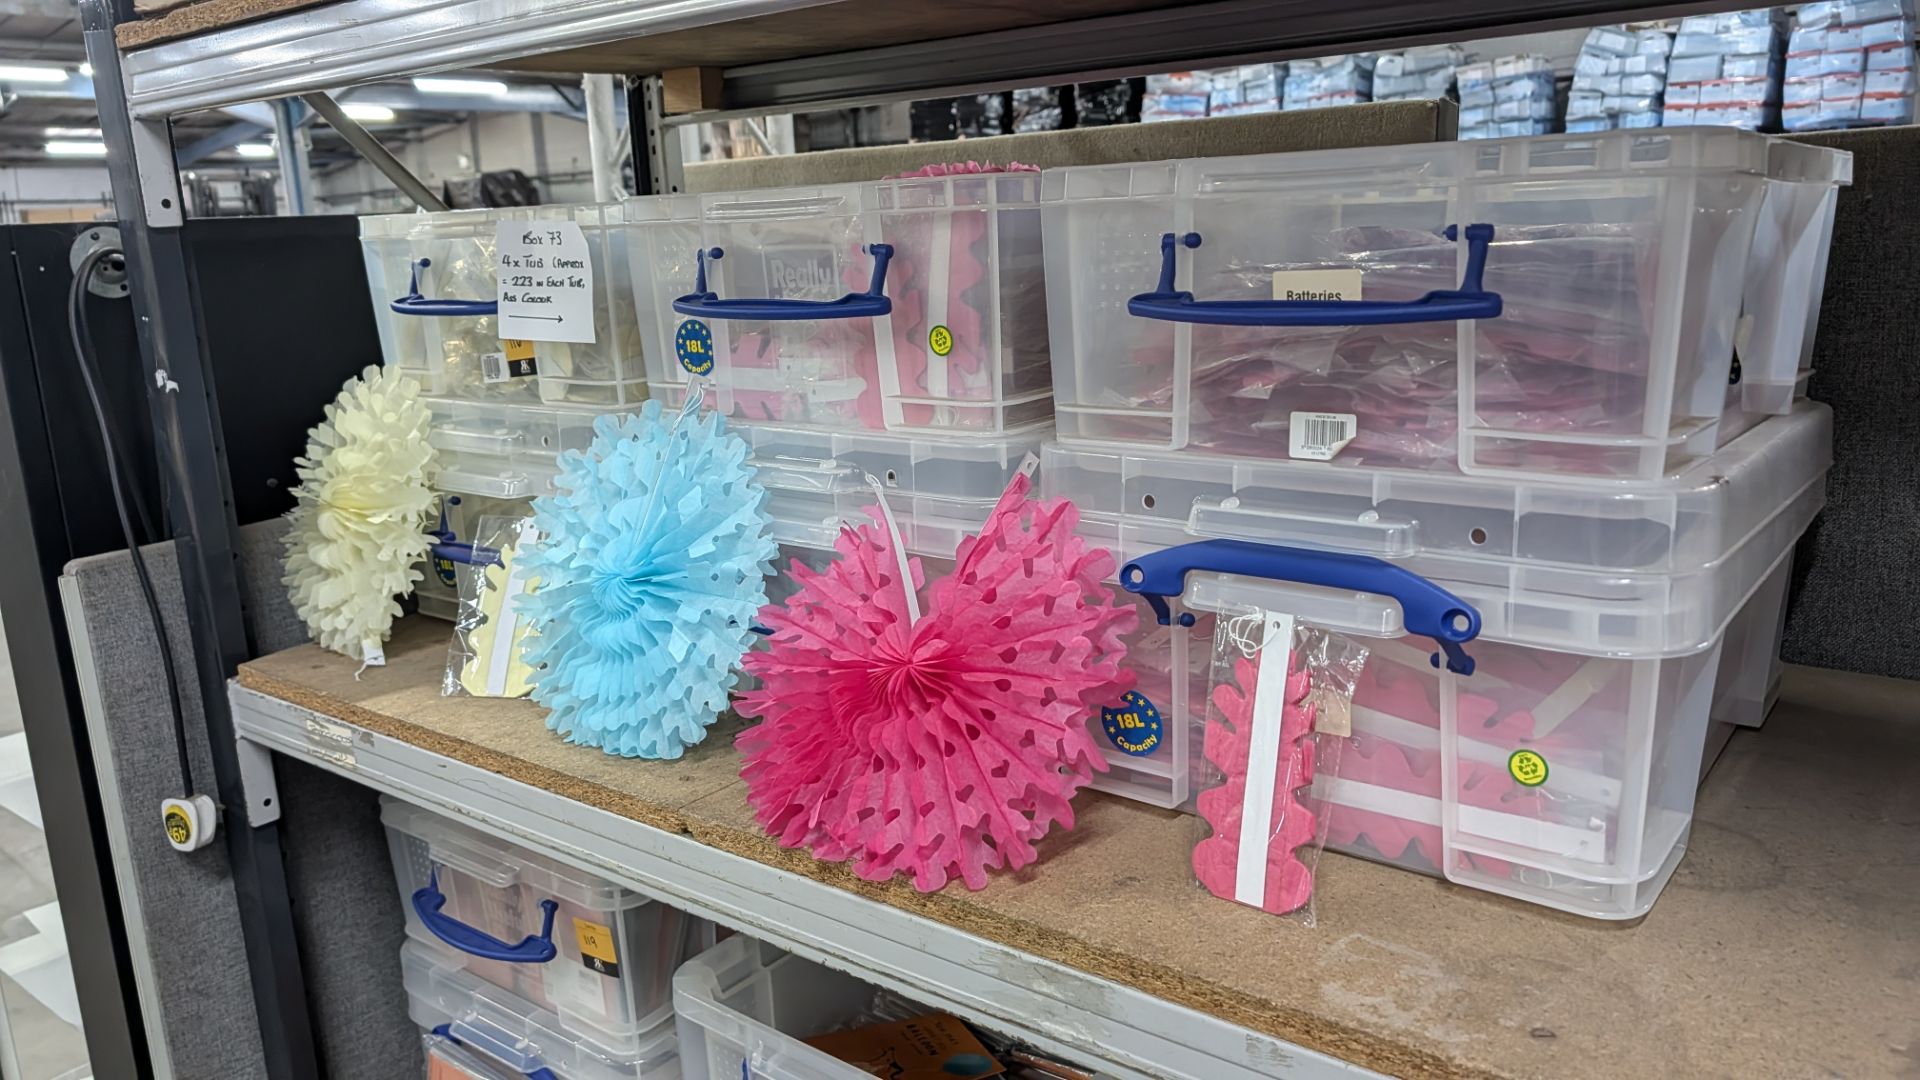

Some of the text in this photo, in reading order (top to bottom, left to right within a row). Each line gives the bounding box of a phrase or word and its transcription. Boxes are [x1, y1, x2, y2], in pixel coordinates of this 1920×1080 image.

[546, 230, 562, 246] 73
[522, 254, 544, 268] TUB
[511, 275, 533, 287] 223
[546, 275, 565, 288] EACH
[770, 258, 832, 290] Really
[1286, 289, 1342, 301] Batteries
[686, 339, 705, 353] 18L
[683, 358, 712, 373] Capacity
[1116, 712, 1146, 729] 18L
[1116, 734, 1158, 752] Capacity
